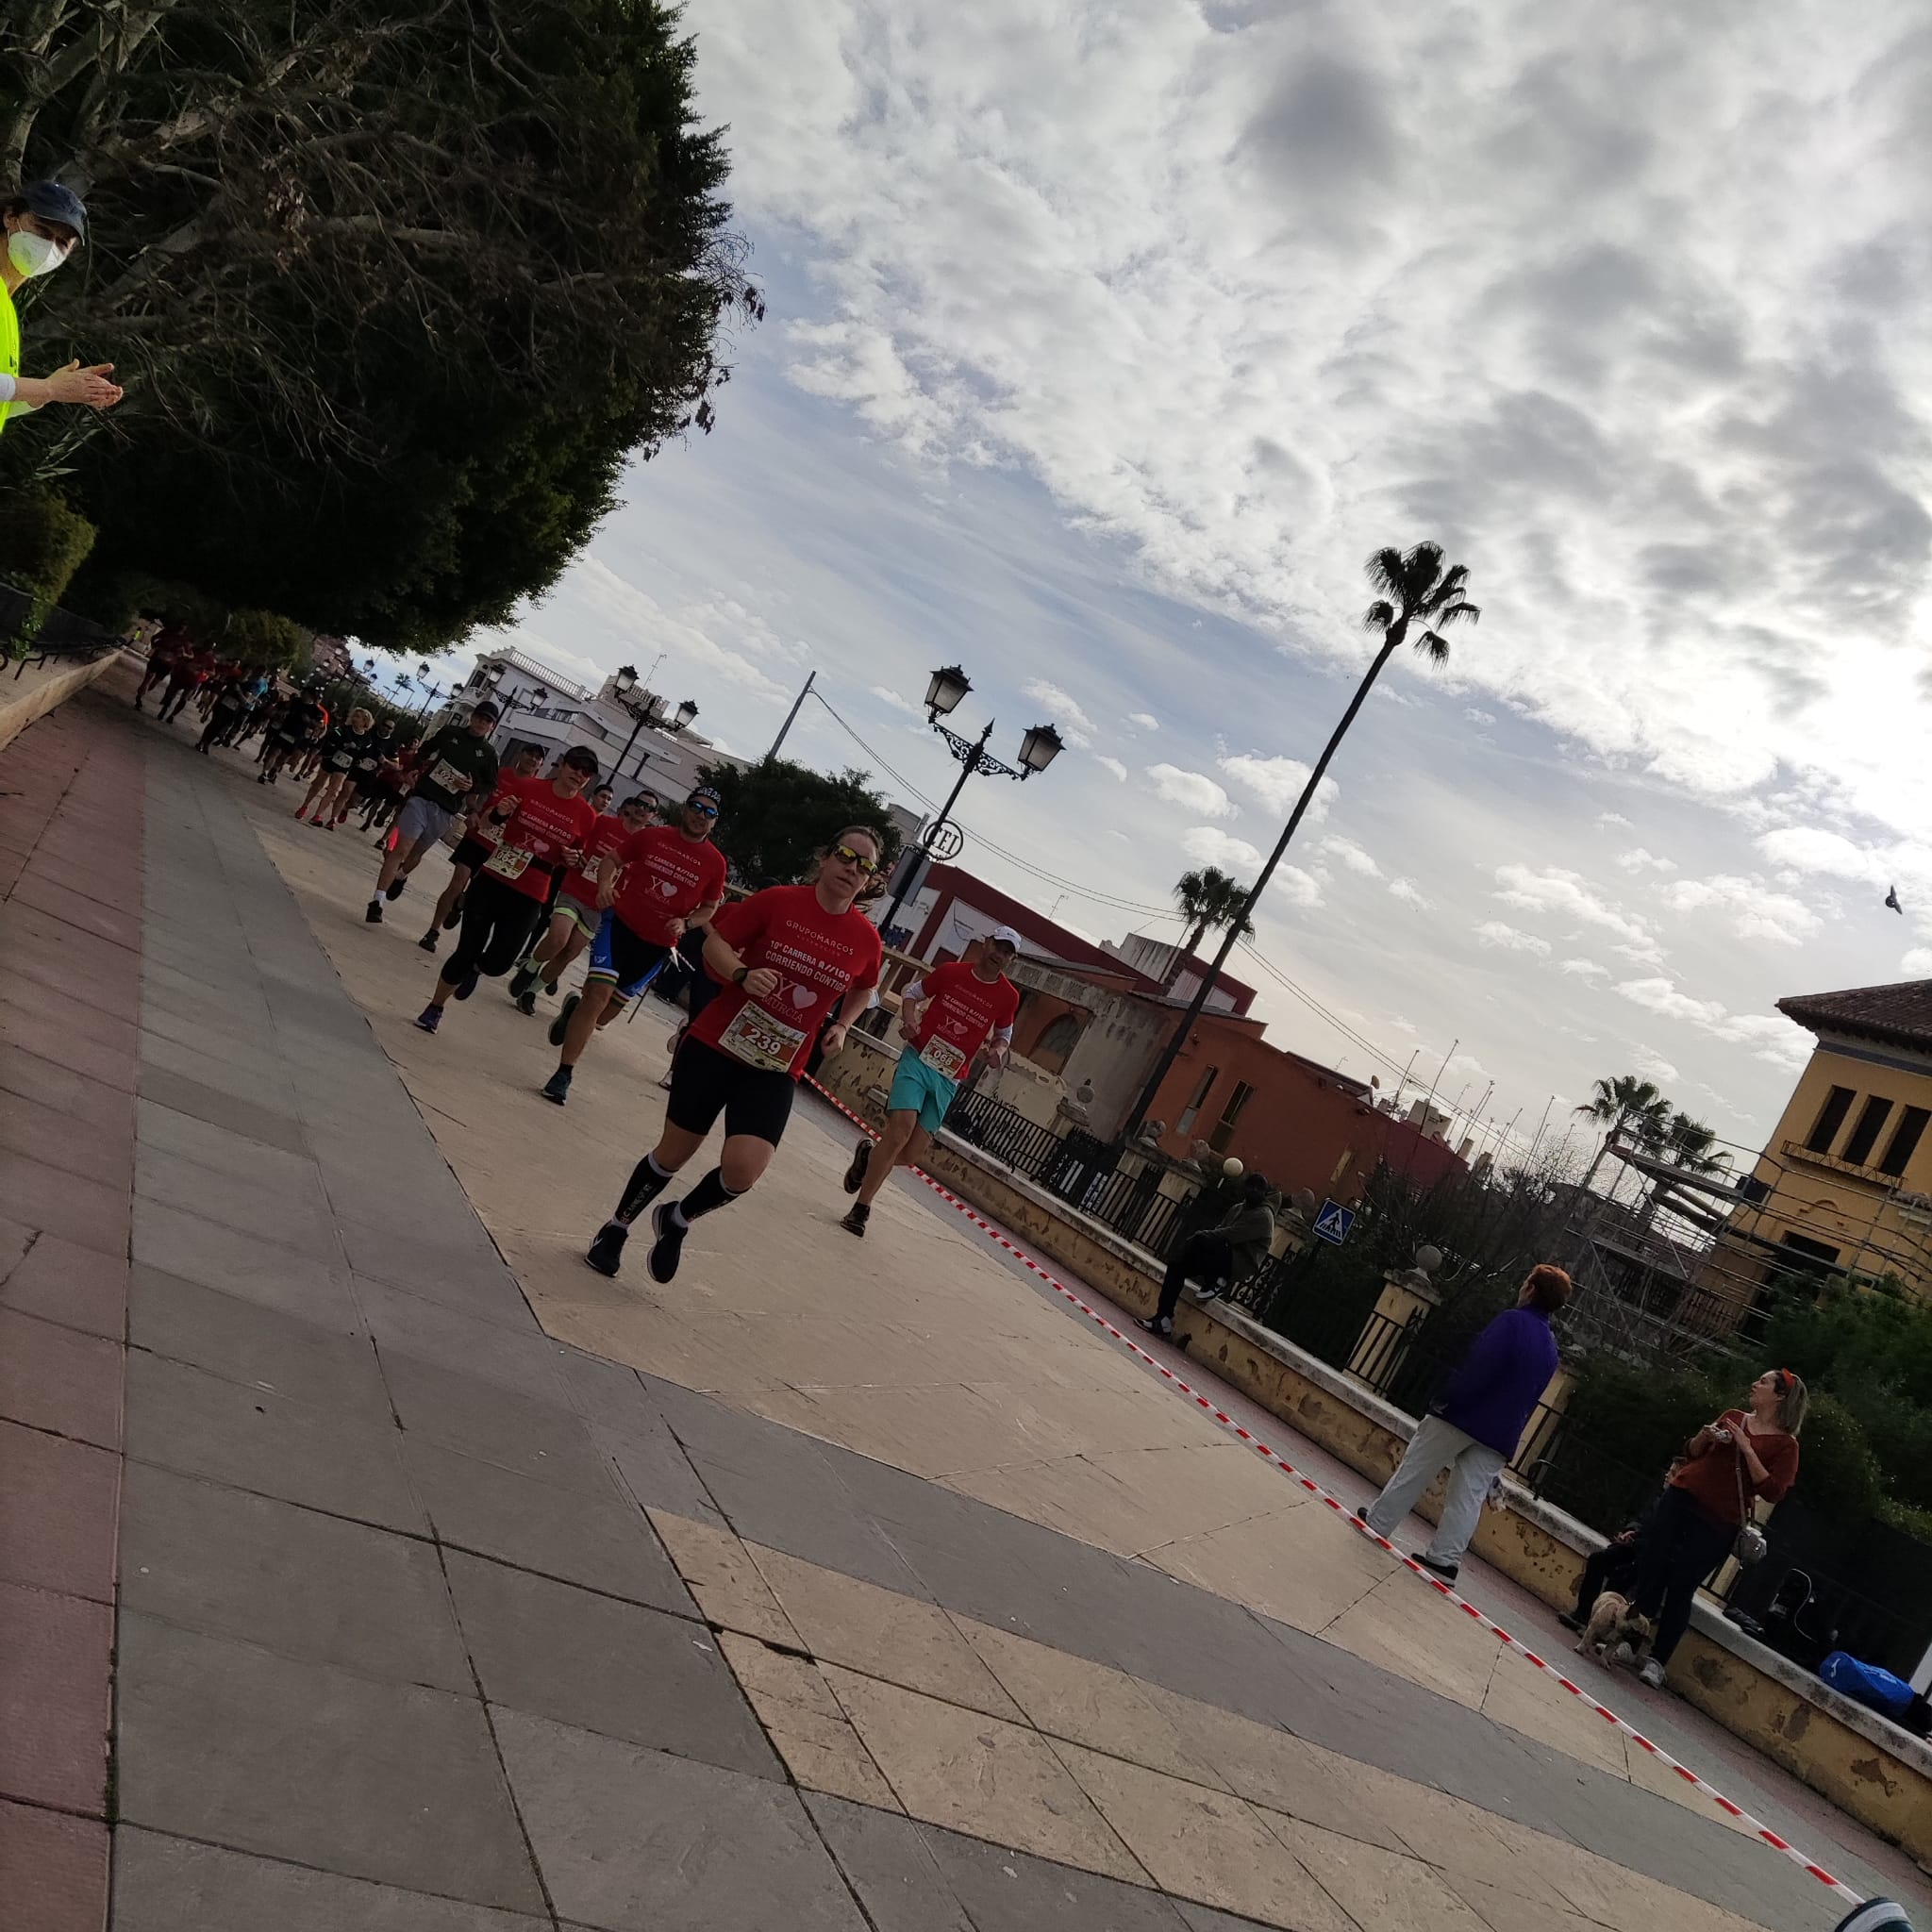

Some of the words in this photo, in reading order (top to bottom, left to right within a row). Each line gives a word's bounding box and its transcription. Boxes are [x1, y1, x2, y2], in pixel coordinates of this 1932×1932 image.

[786, 919, 854, 956] GRUPOMARCOS
[765, 950, 813, 976] CORRIENDO
[782, 944, 818, 966] CARRERA
[761, 995, 804, 1024] MURCIA
[745, 1027, 782, 1056] 239
[933, 1050, 954, 1066] 068
